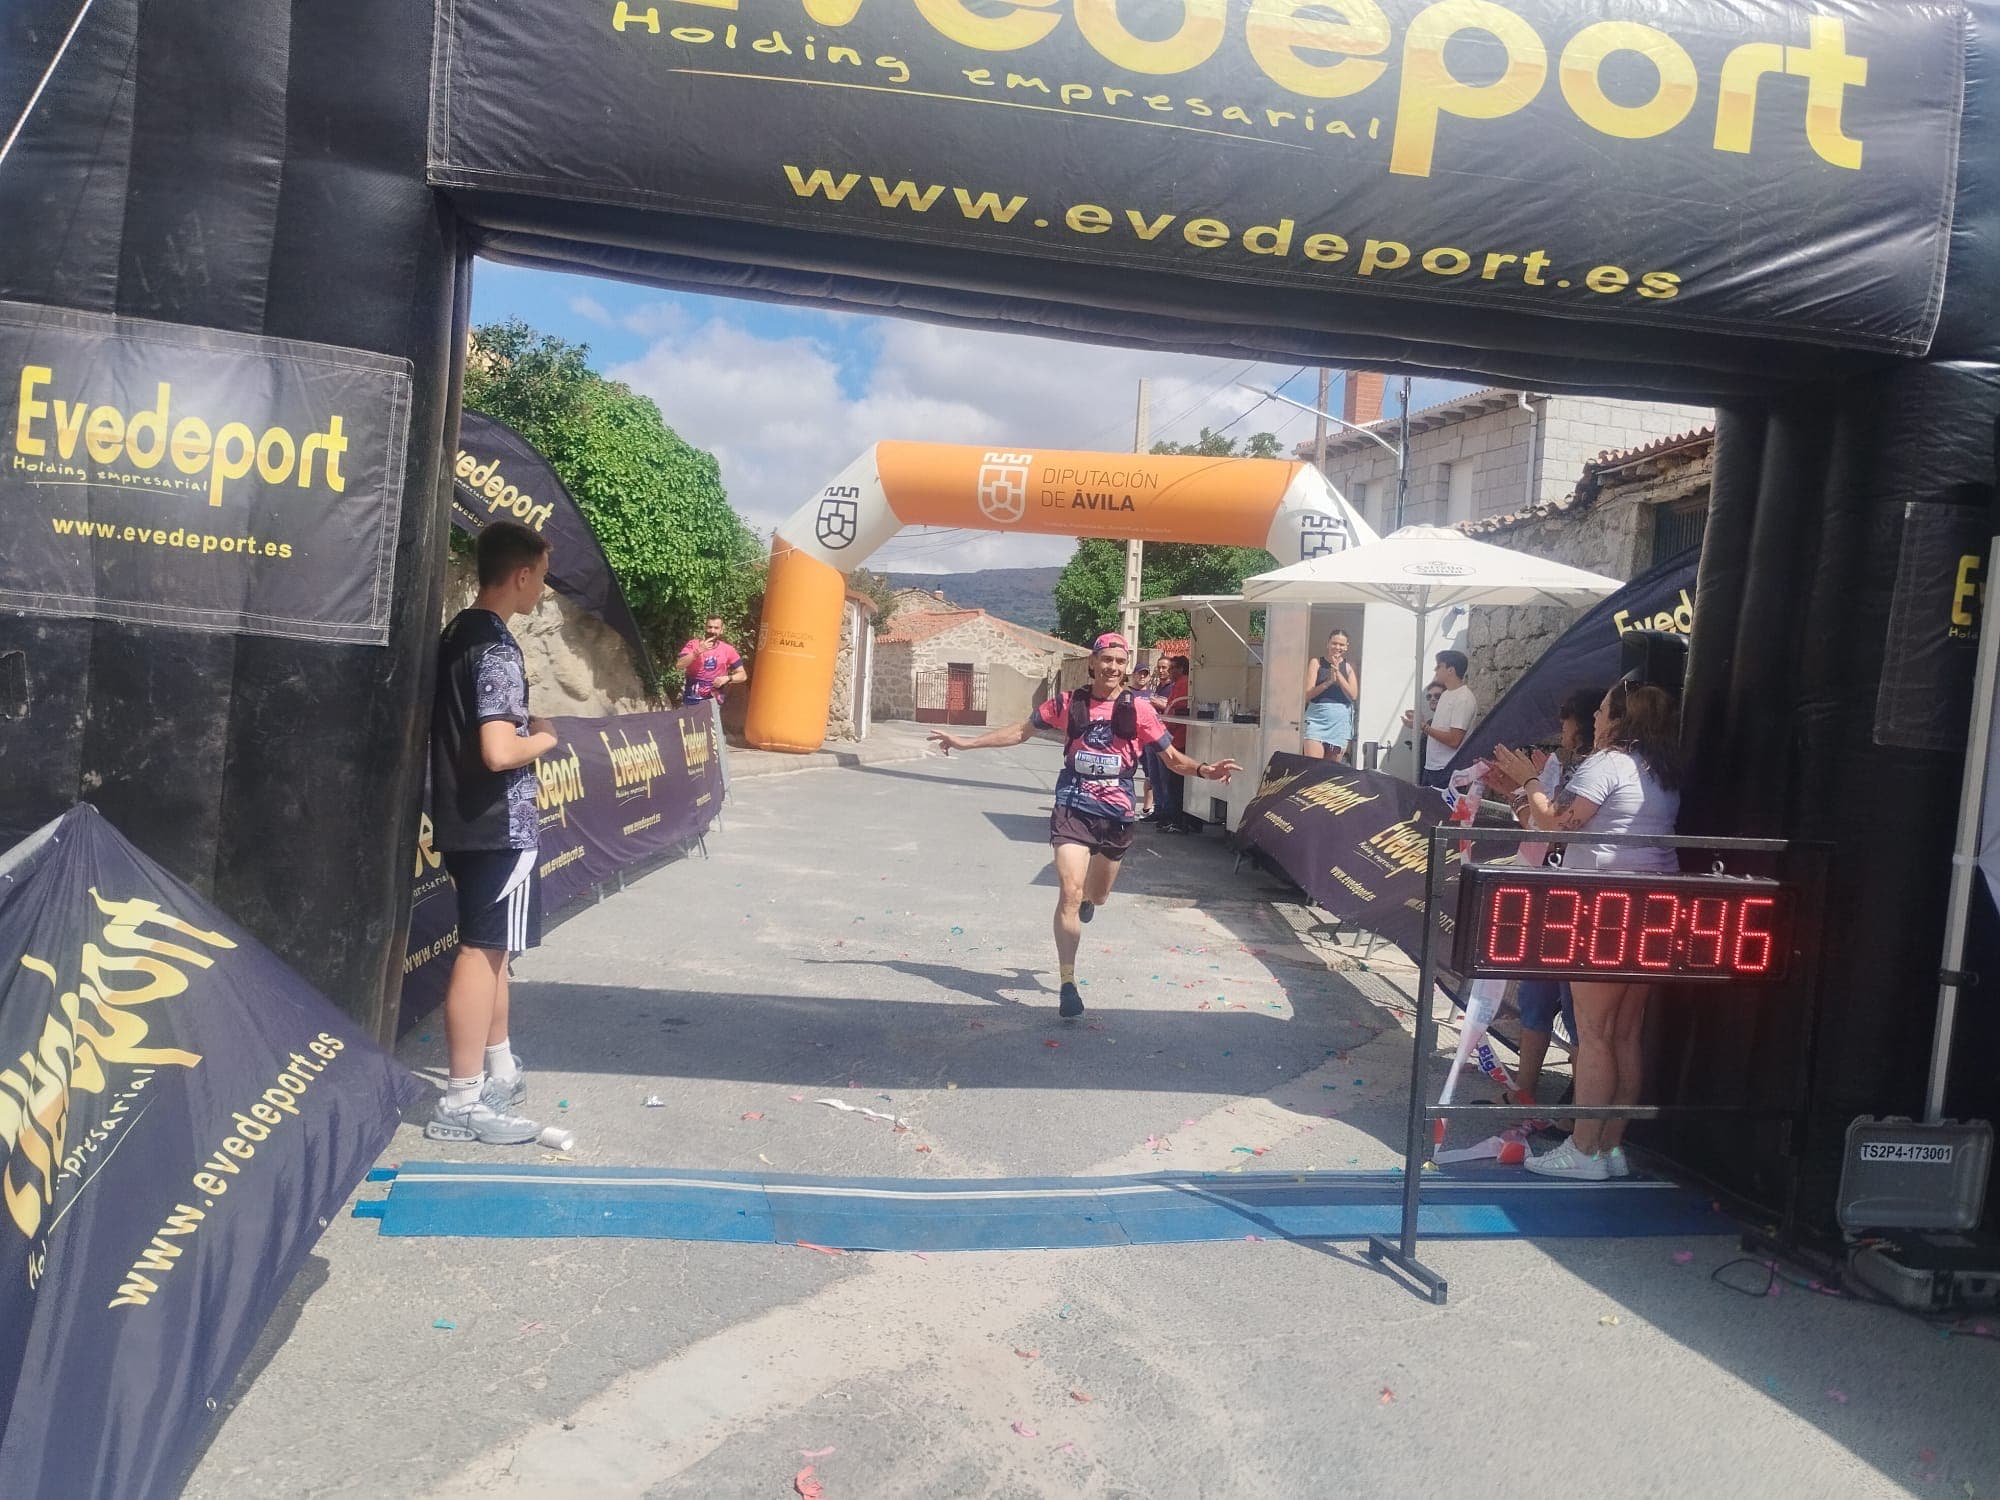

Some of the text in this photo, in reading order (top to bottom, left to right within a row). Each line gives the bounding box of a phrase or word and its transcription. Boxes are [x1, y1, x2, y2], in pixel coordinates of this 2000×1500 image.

[612, 1, 1379, 140] Holding empresarial
[782, 164, 1682, 300] www.evedeport.es
[16, 365, 349, 507] Evedeport
[13, 456, 208, 492] Holding empresarial
[1042, 468, 1158, 489] DIPUTACIÓN
[1041, 489, 1135, 512] DE ÁVILA
[52, 518, 292, 559] www.evedeport.es
[1089, 764, 1105, 775] 13
[1488, 887, 1774, 972] 03:02:46
[108, 1031, 345, 1309] www.evedeport.es
[1863, 1144, 1951, 1161] TS2P4-173001
